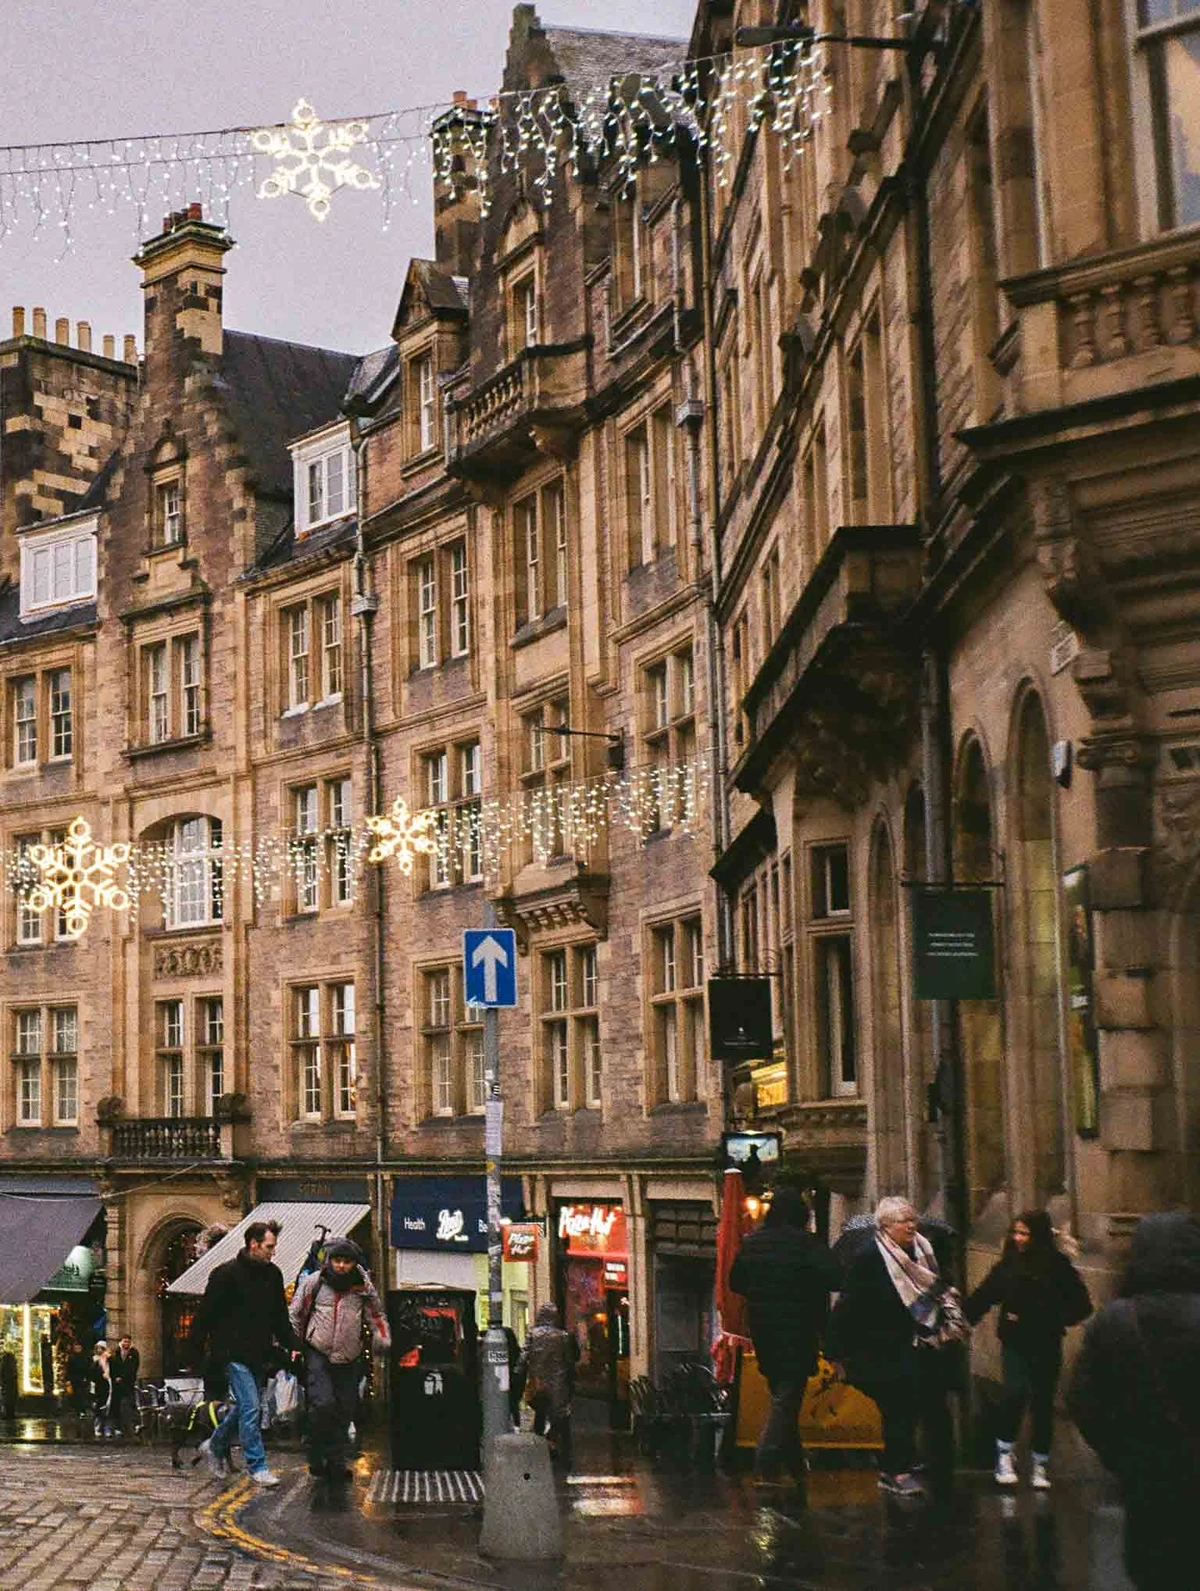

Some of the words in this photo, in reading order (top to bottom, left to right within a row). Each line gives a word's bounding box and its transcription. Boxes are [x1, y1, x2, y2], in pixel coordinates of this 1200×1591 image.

[404, 1216, 426, 1231] Health
[558, 1205, 591, 1238] Pizza
[589, 1207, 617, 1236] Hut
[508, 1233, 535, 1245] Pizza
[511, 1245, 532, 1255] Hut
